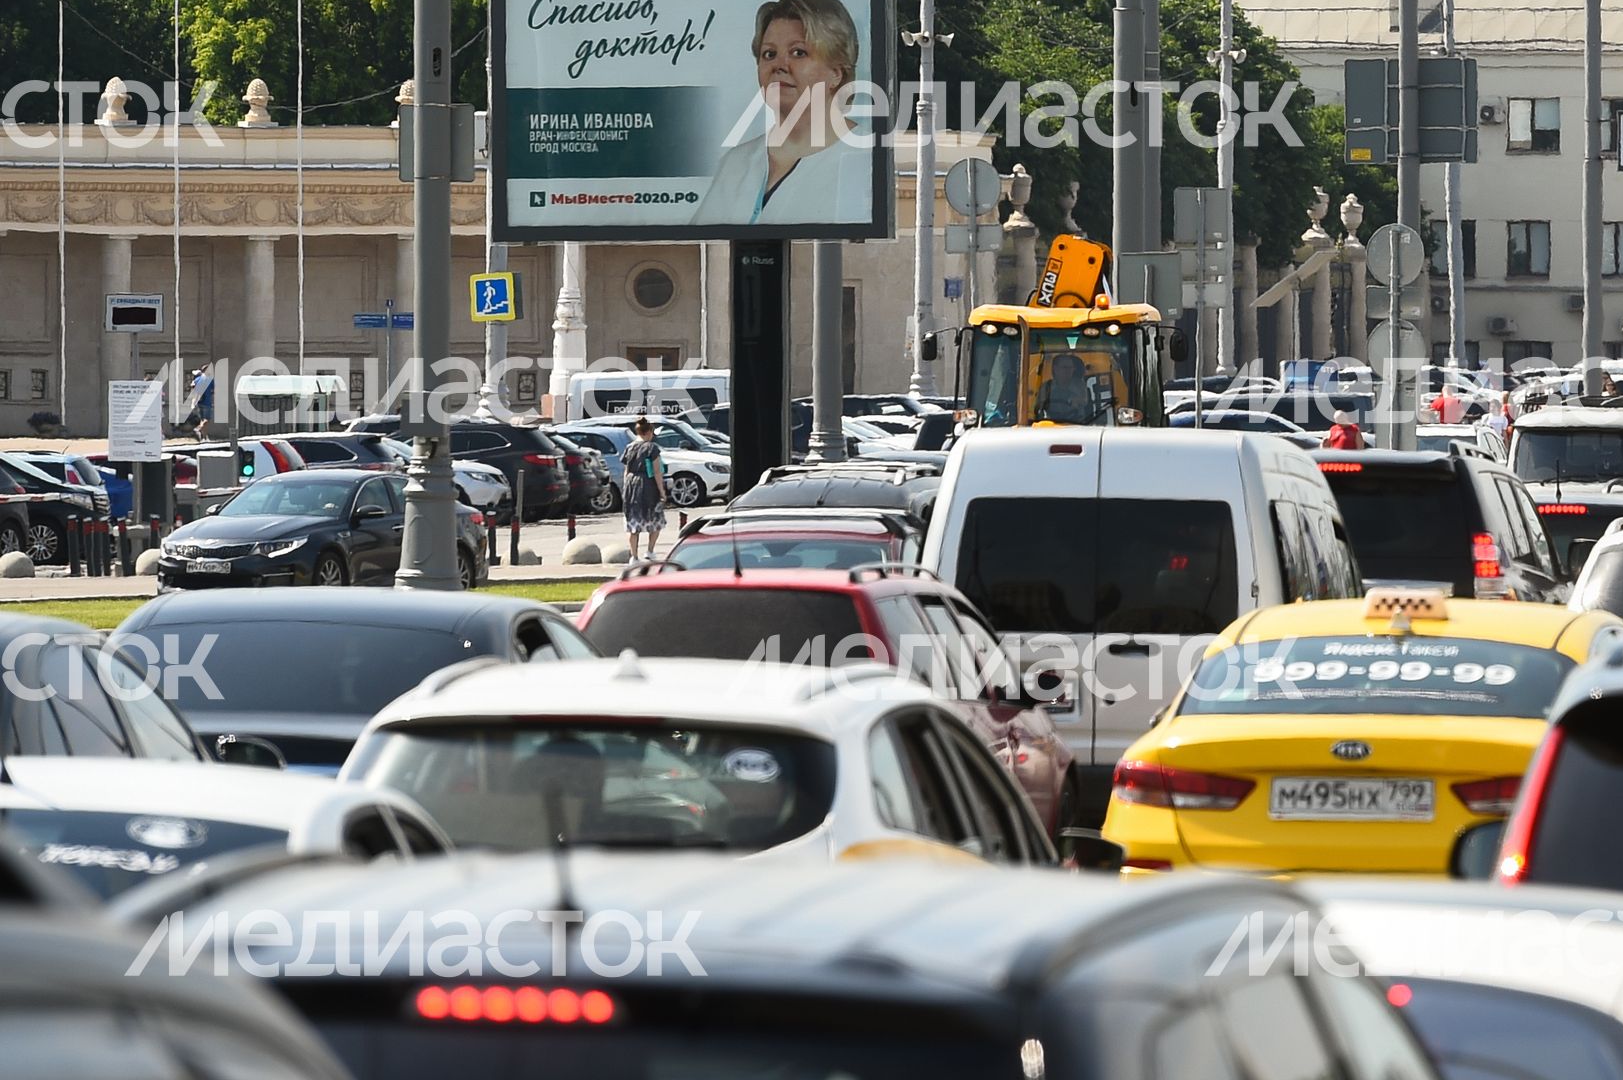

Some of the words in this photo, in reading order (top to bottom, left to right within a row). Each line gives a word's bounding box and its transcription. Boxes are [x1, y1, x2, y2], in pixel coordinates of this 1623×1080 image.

[567, 9, 716, 79] доктор!
[529, 114, 579, 130] ИРИНА
[584, 113, 654, 129] ИВАНОВА
[529, 130, 629, 142] ВРАЧ-ИНФЕКЦИОНИСТ
[529, 142, 559, 154] ГОРОД
[561, 142, 599, 153] МОСКВА
[551, 191, 699, 205] МыВместе2020.РФ
[614, 406, 647, 414] POWER
[651, 405, 686, 414] EVENTS
[1253, 660, 1516, 686] 999-99-99
[1278, 780, 1381, 810] М495НХ
[1387, 781, 1426, 804] 799
